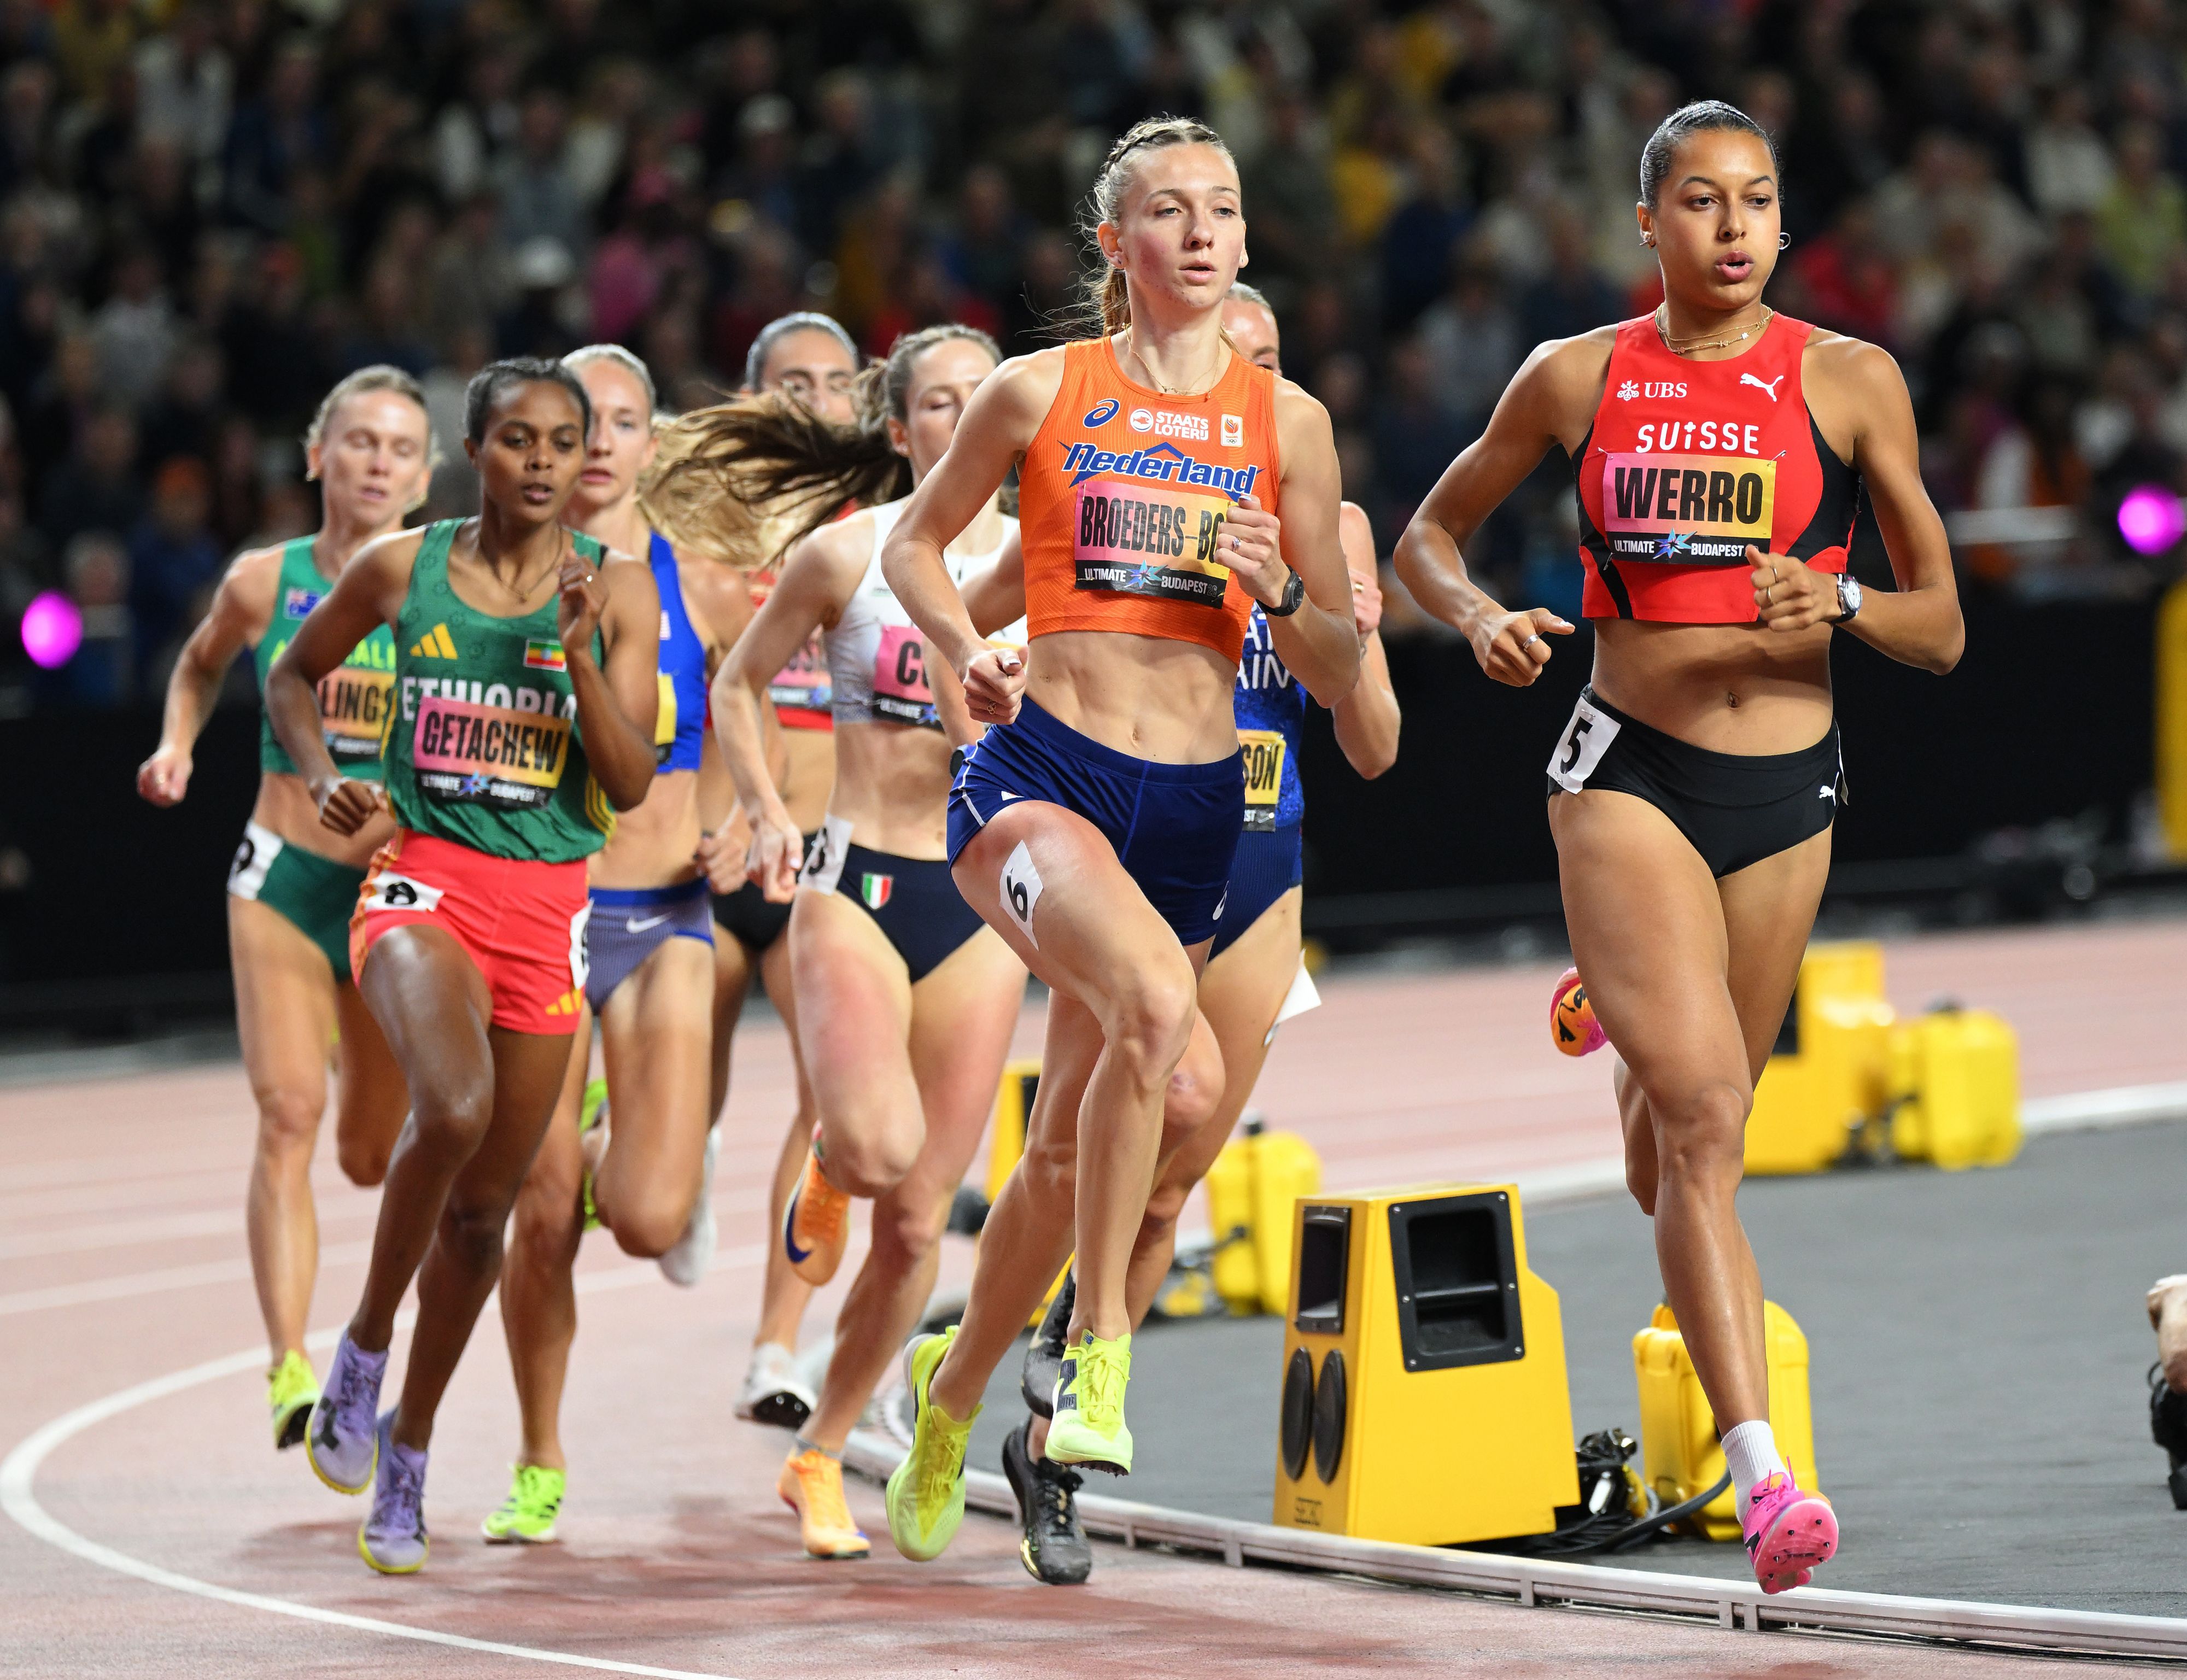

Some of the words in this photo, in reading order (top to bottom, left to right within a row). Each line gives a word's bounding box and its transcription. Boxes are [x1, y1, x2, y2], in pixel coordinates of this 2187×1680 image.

[1644, 382, 1687, 398] UBS
[1156, 412, 1208, 430] STAATS
[1615, 467, 1763, 525] WERRO
[1080, 496, 1225, 564] BROEDERS-BO
[1614, 540, 1655, 554] ULTIMATE
[1691, 543, 1744, 557] BUDAPEST
[1085, 568, 1126, 582] ULTIMATE
[1161, 576, 1208, 594] BUDAPEST
[422, 711, 564, 773] GETACHEW
[1559, 716, 1593, 774] 5
[1007, 868, 1028, 923] 6
